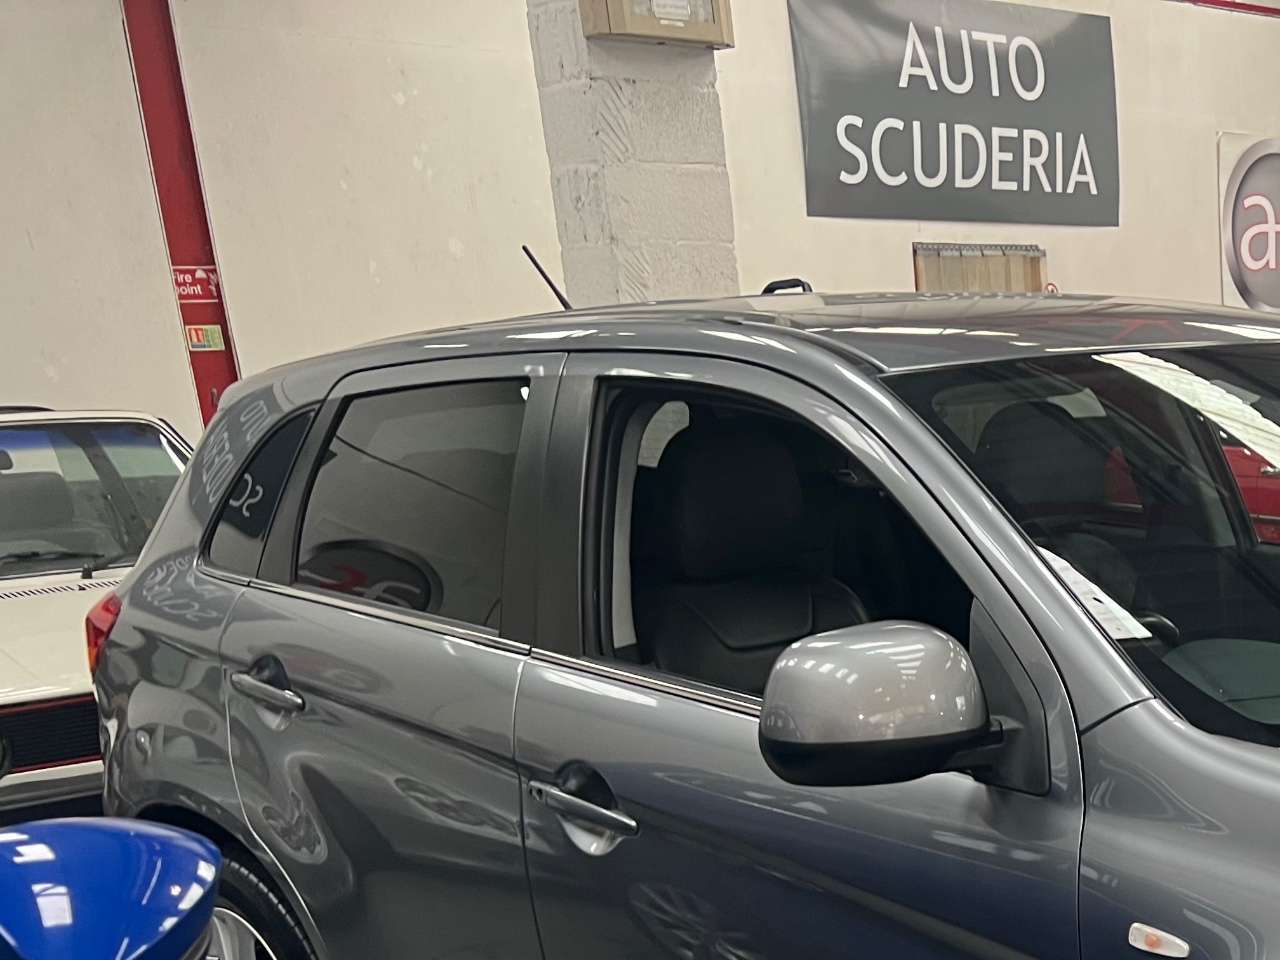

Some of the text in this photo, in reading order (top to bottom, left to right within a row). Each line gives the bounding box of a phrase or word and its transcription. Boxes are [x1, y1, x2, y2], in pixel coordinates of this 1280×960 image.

[898, 21, 1045, 101] AUTO
[836, 114, 1098, 195] SCUDERIA
[174, 271, 193, 283] ire
